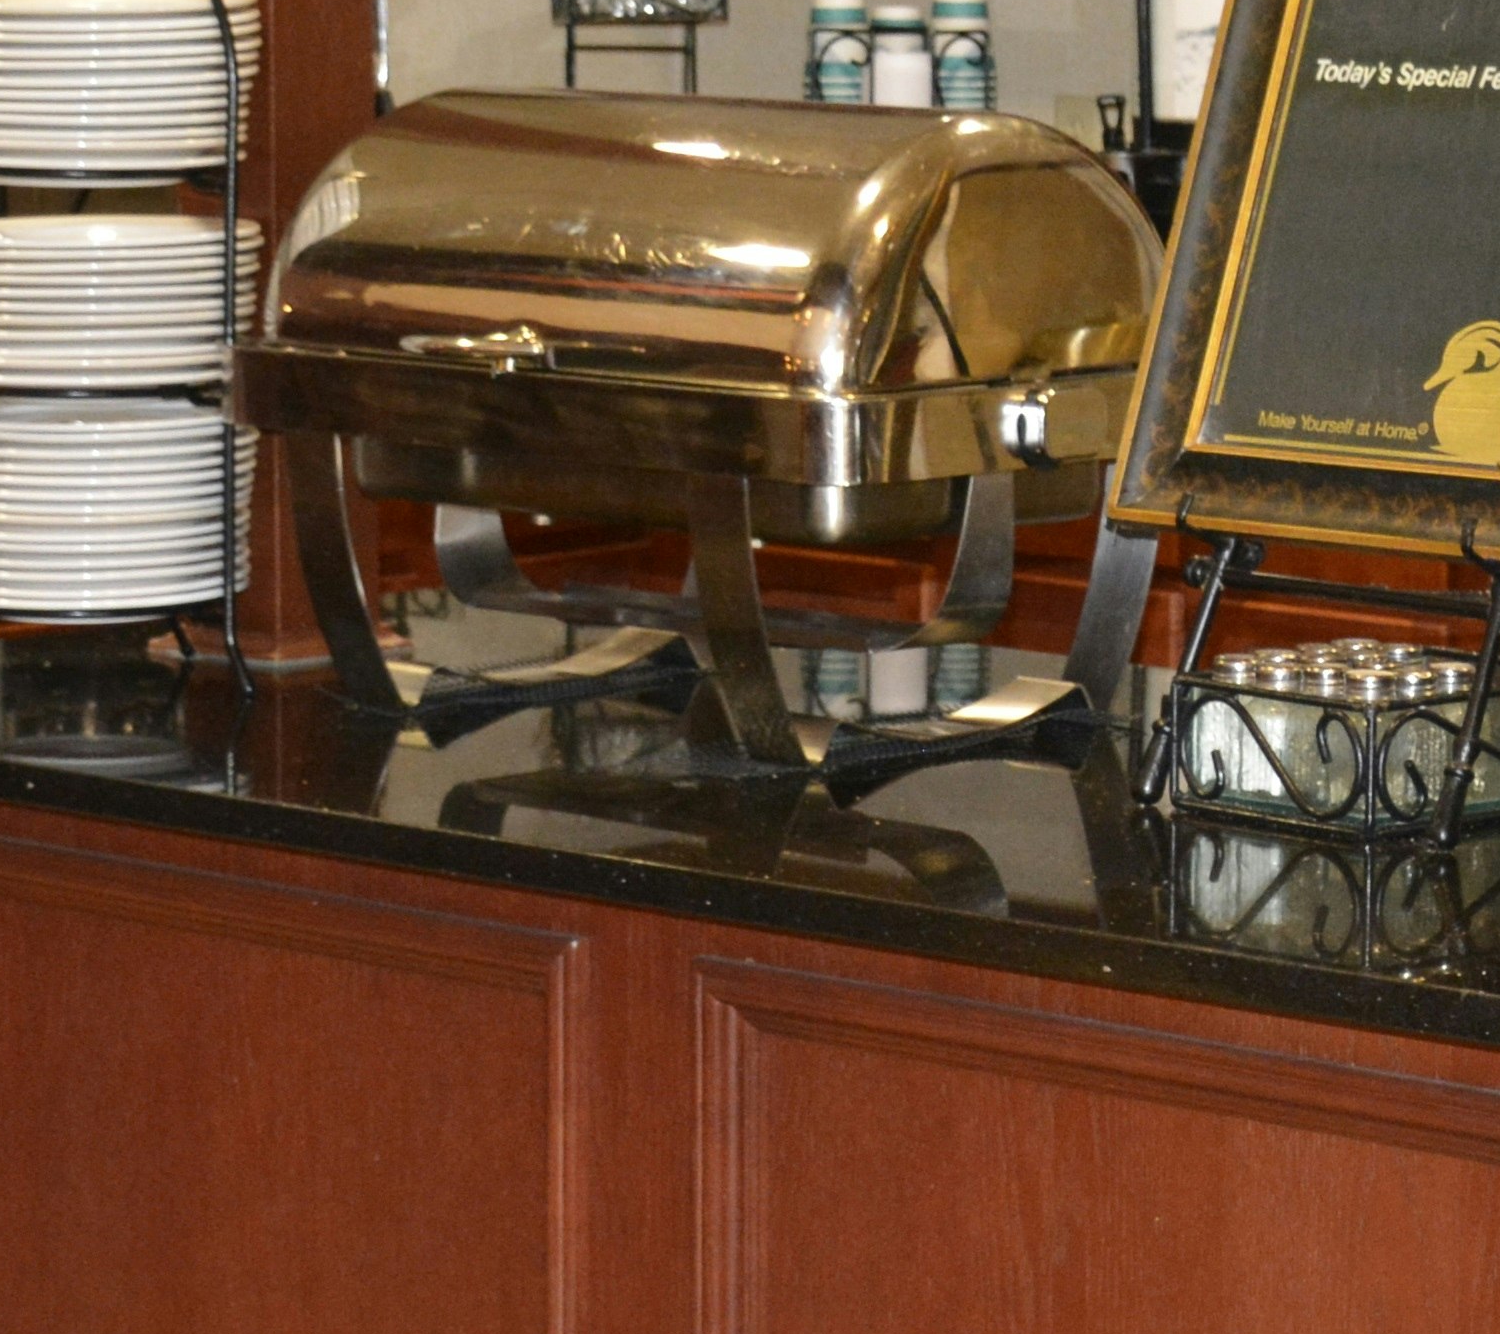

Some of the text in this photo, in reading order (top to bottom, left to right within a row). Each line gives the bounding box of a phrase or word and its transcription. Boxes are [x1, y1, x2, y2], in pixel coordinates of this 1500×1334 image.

[1315, 58, 1393, 89] Today's
[1396, 62, 1477, 91] Special
[1258, 410, 1297, 430] Make
[1301, 414, 1355, 435] Yourself
[1356, 421, 1372, 437] at
